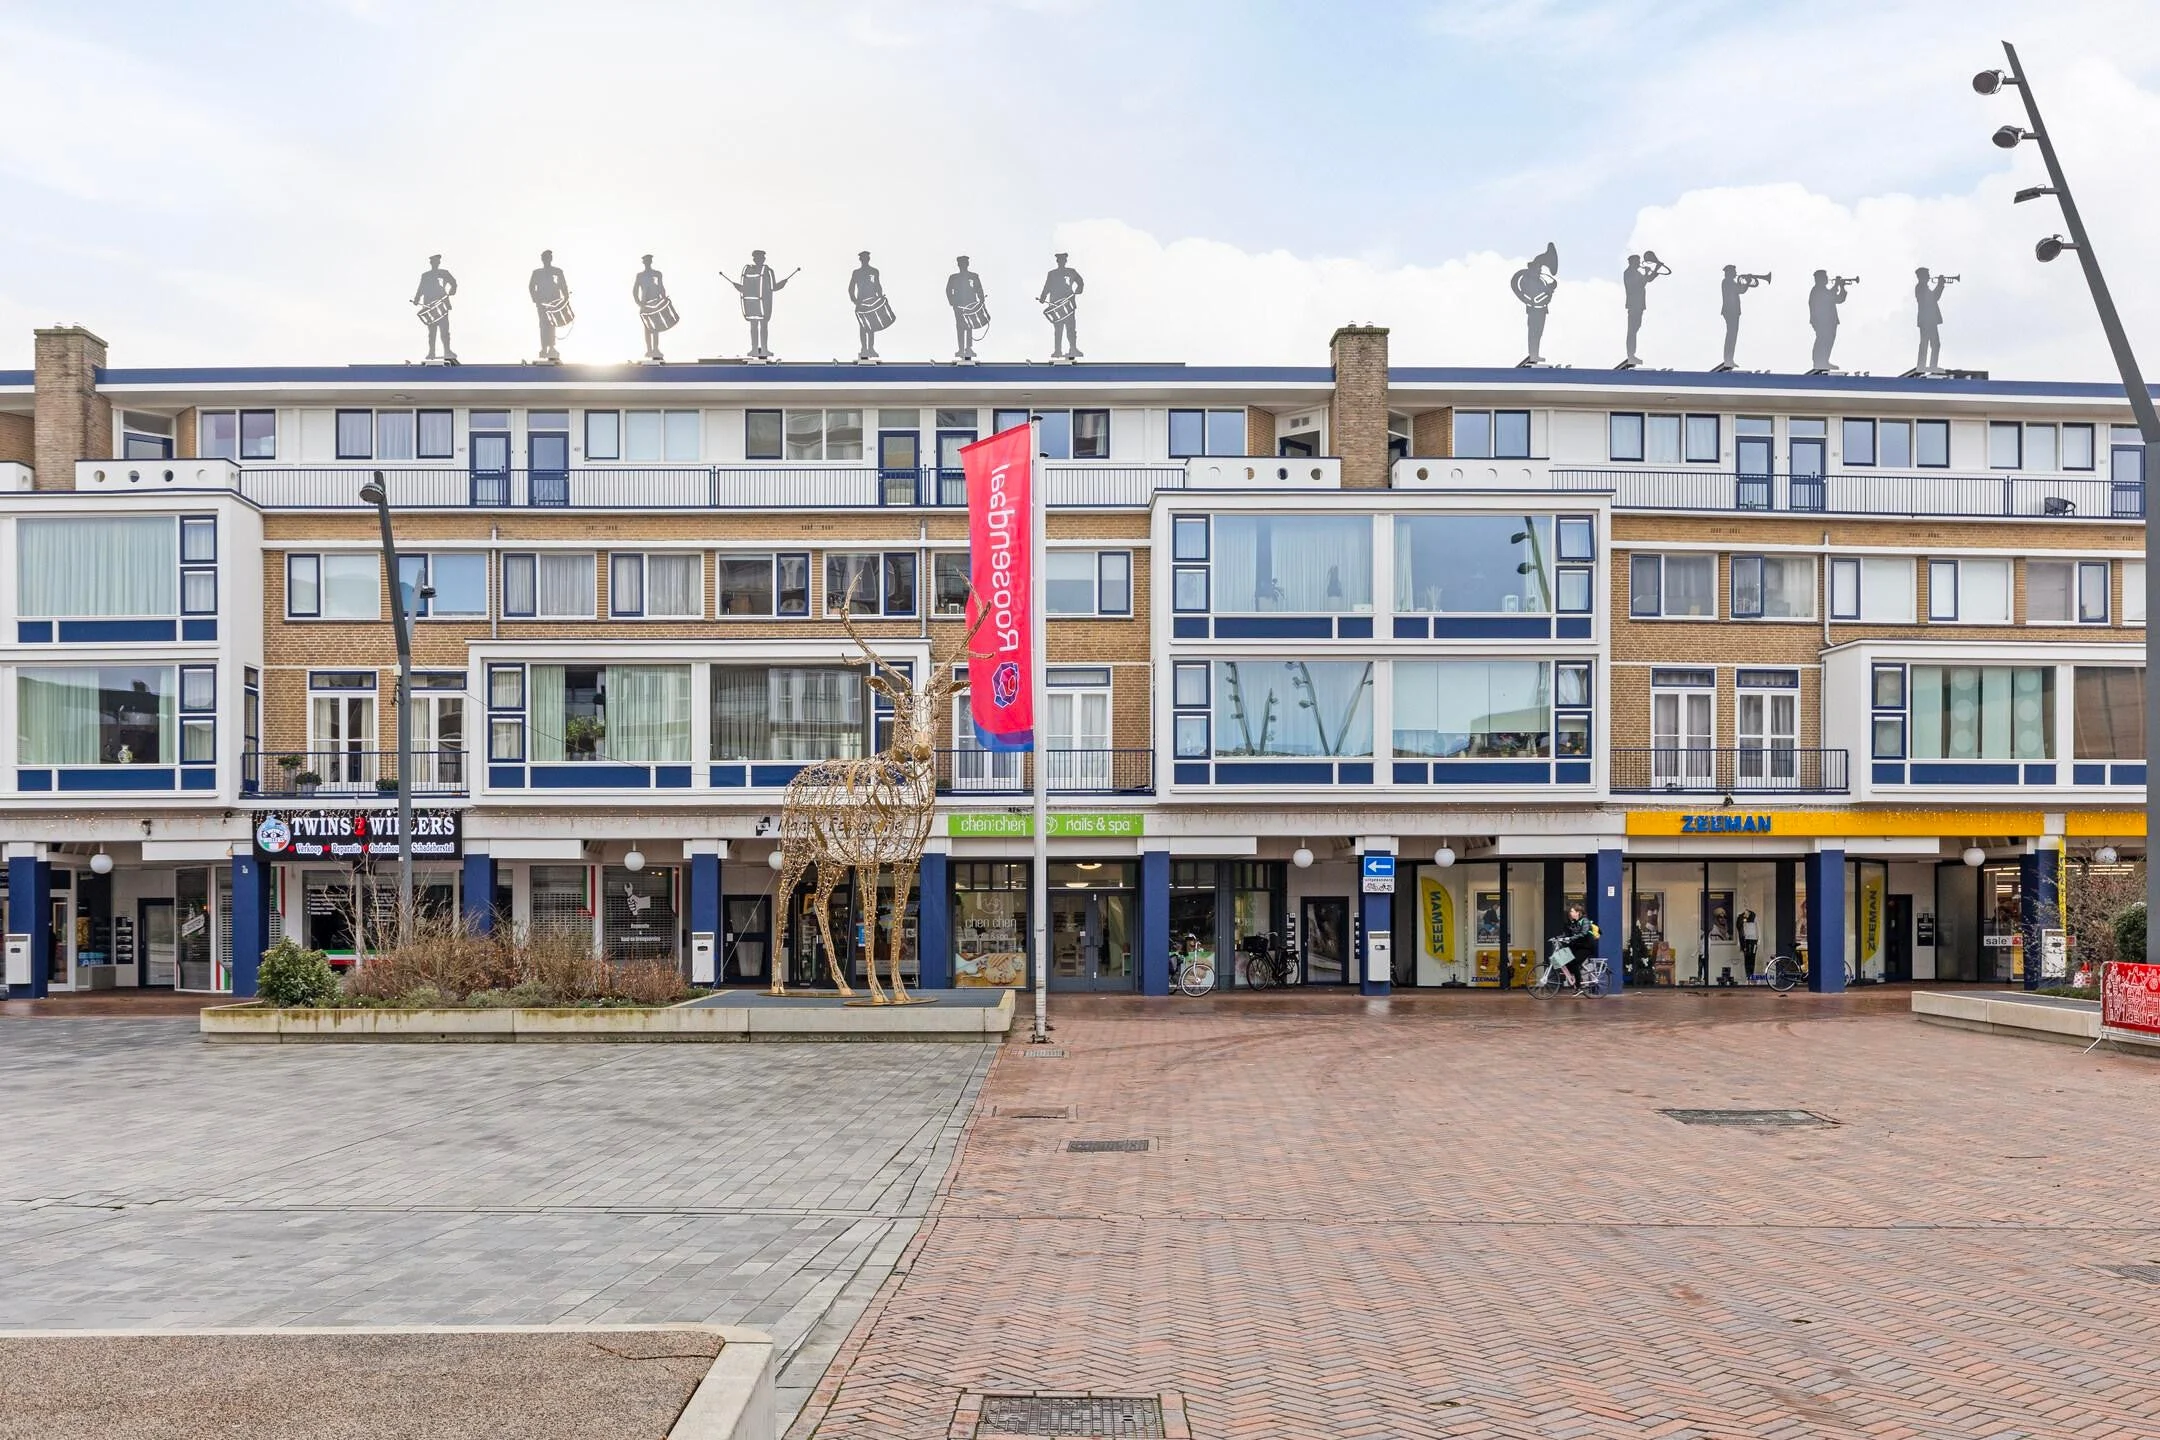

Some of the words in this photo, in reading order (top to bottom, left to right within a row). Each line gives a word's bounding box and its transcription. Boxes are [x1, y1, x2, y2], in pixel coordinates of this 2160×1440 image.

[291, 811, 351, 836] TWINS
[353, 816, 367, 837] 2
[961, 815, 992, 832] chen
[1066, 816, 1093, 832] nails
[1096, 817, 1106, 831] &
[1108, 819, 1130, 834] spa
[1681, 815, 1772, 833] ZEEMAN
[296, 843, 322, 855] Verkoop
[369, 843, 399, 853] Onderhou
[965, 912, 990, 929] chen
[1867, 890, 1878, 952] ZEEMAN
[1985, 936, 2007, 945] sale
